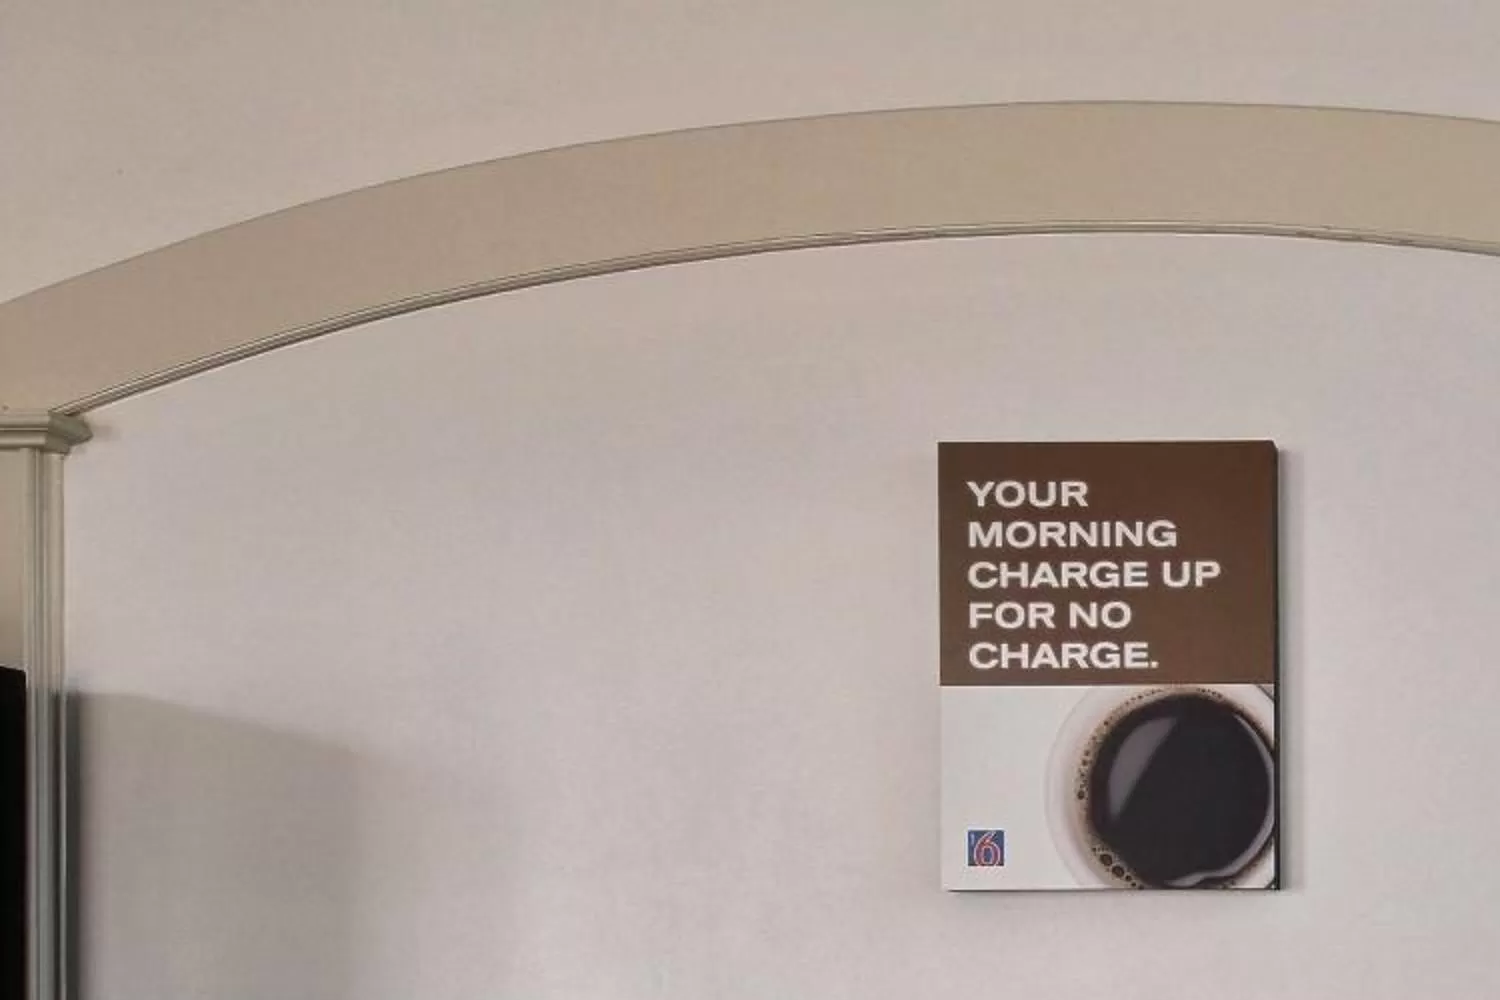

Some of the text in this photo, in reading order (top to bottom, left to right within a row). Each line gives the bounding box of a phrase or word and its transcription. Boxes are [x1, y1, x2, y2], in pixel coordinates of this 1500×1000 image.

[967, 480, 1088, 507] YOUR
[968, 520, 1178, 547] MORNING
[968, 561, 1221, 588] CHARGE UP
[969, 601, 1132, 628] FOR NO
[969, 642, 1158, 669] CHARGE.
[974, 831, 1001, 866] 6
